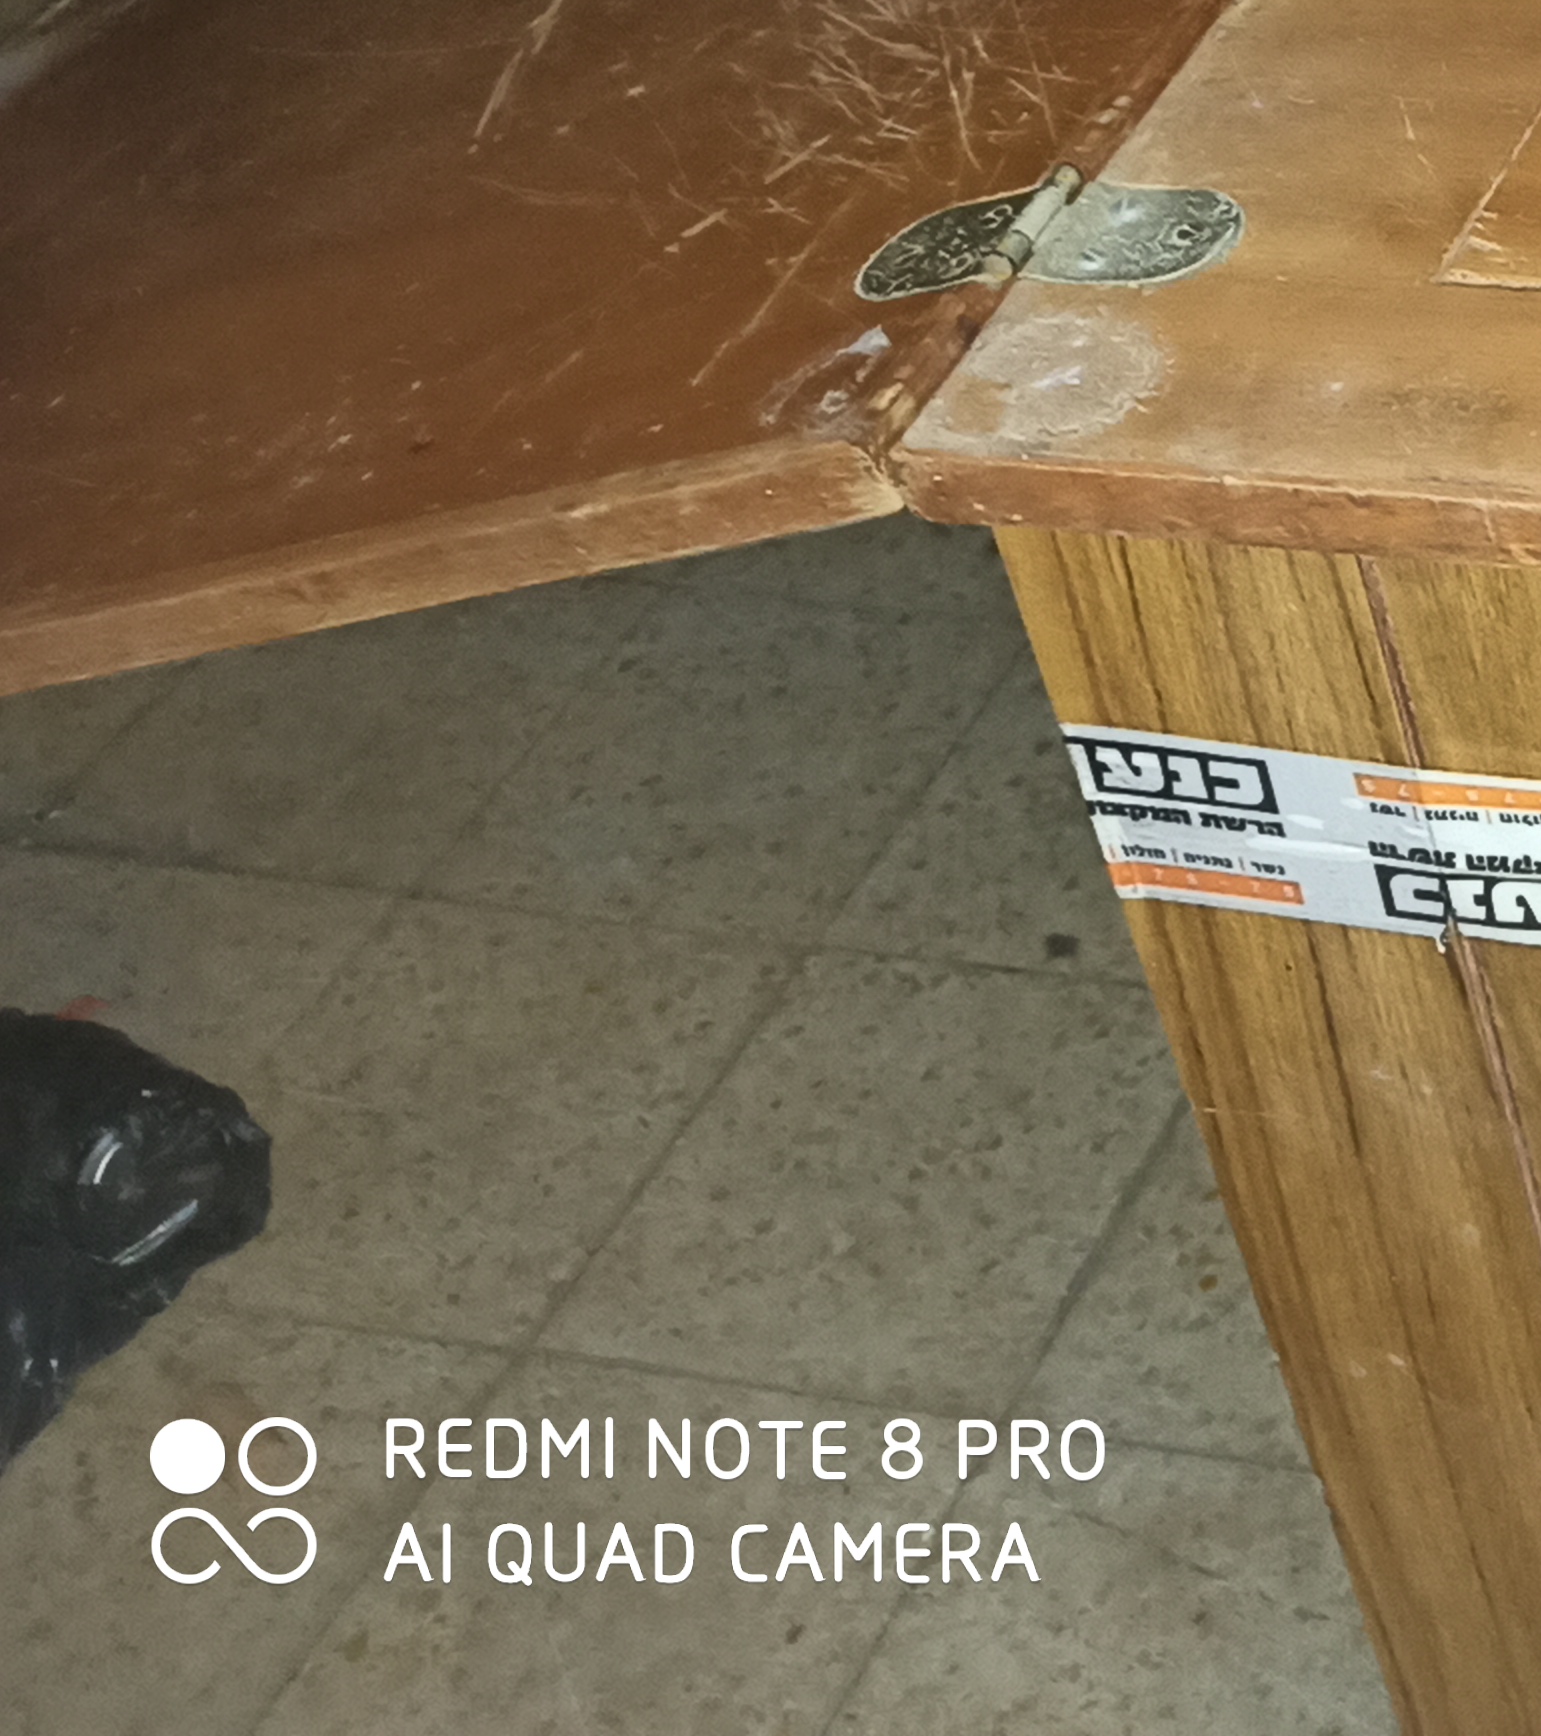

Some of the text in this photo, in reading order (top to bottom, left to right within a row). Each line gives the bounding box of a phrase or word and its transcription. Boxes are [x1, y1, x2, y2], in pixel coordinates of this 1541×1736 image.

[1198, 811, 1287, 838] הרשת
[1251, 860, 1286, 876] נשר
[1367, 840, 1457, 870] הרשת
